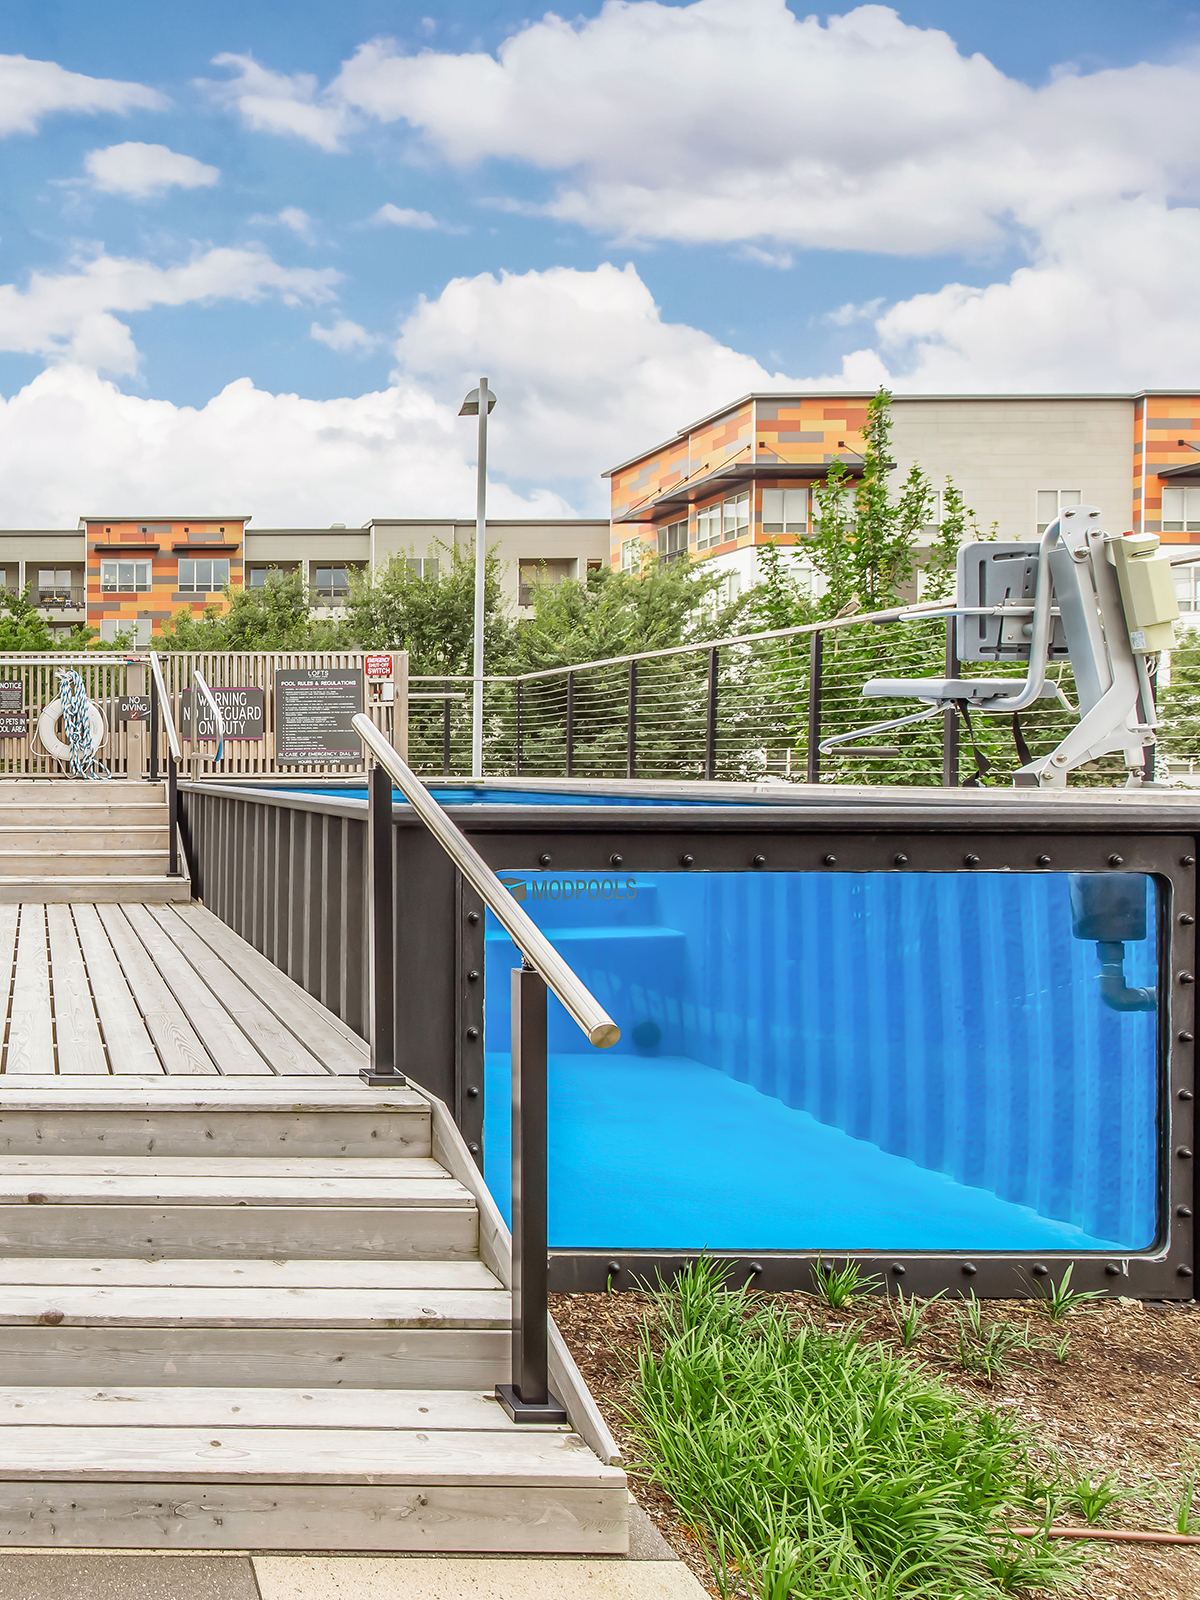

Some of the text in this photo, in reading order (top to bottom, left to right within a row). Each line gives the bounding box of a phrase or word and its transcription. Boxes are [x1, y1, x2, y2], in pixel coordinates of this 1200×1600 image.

[197, 692, 247, 706] WRNING
[122, 704, 148, 712] DIVING
[203, 706, 262, 720] LIEGUARD
[198, 720, 246, 735] ON DUTY
[532, 878, 637, 900] MODPOOLS
